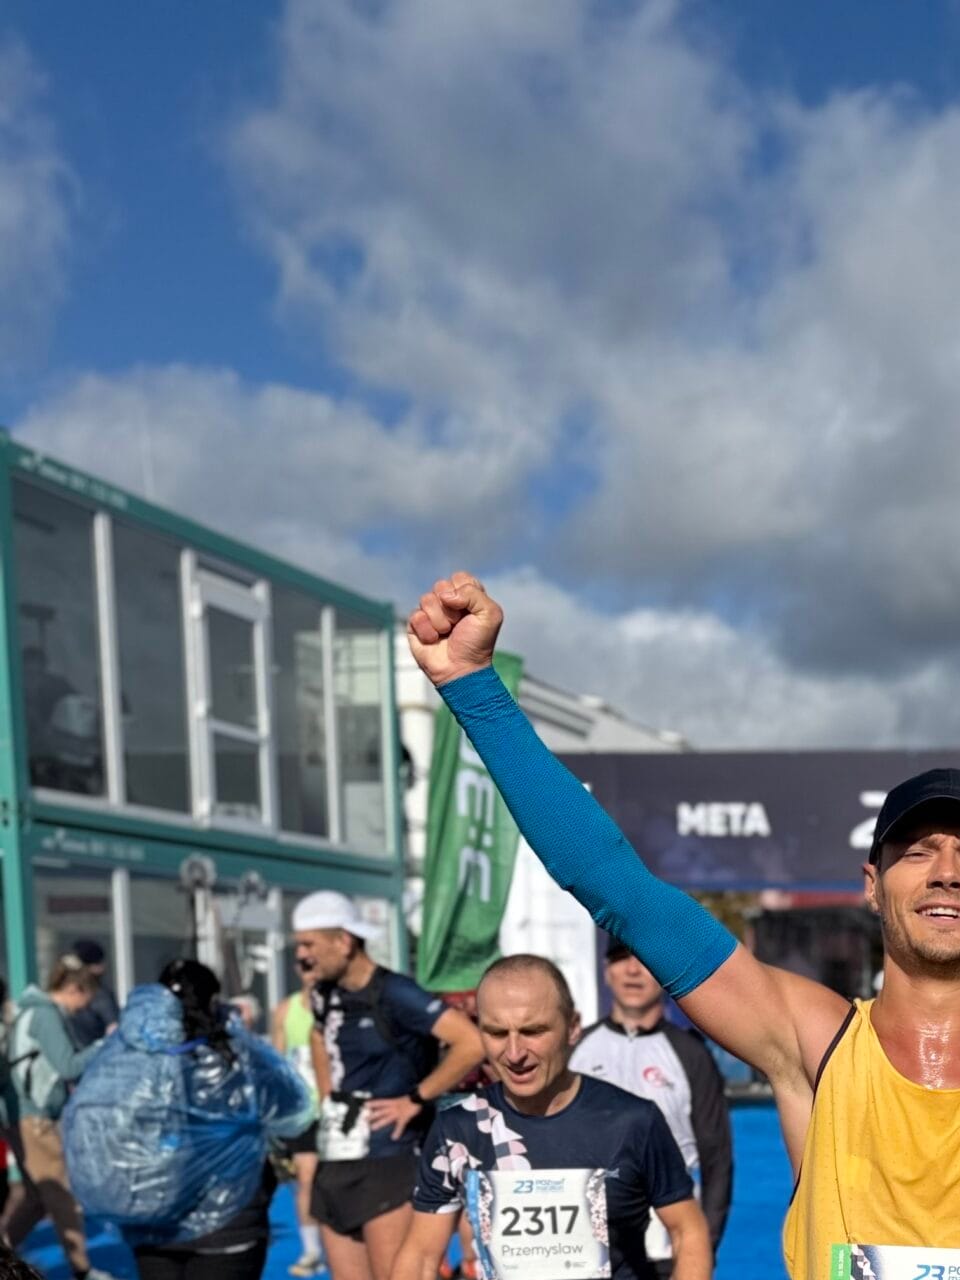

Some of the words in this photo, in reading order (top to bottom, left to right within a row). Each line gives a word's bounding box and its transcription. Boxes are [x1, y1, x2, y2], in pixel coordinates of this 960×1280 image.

[678, 803, 771, 836] META
[513, 1180, 534, 1194] 23
[501, 1205, 579, 1236] 2317
